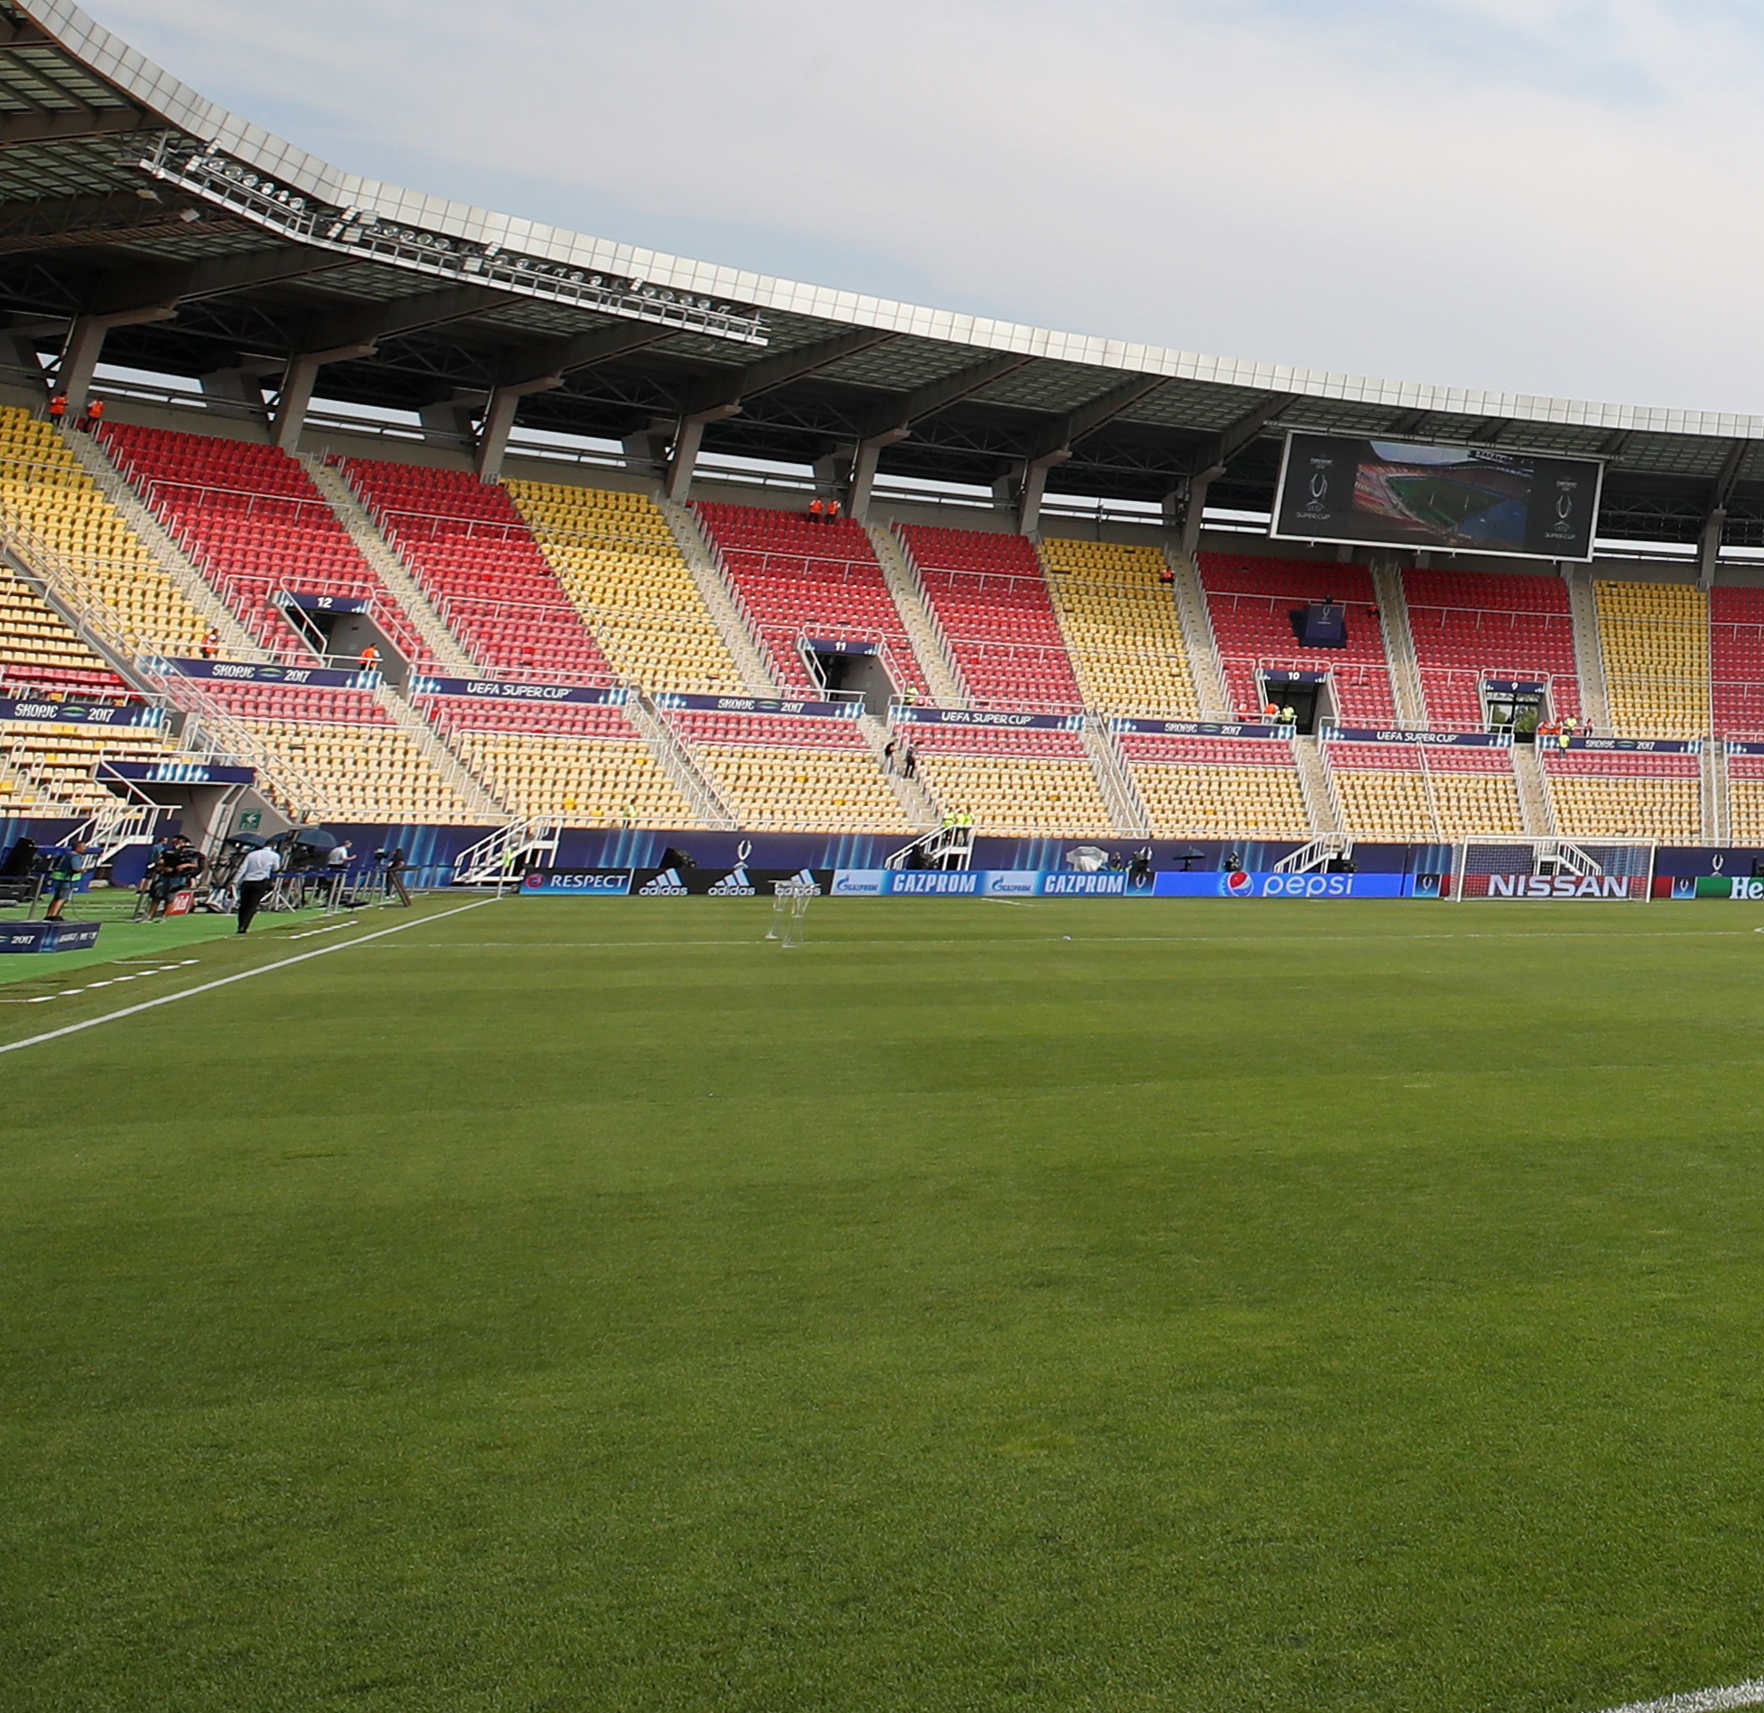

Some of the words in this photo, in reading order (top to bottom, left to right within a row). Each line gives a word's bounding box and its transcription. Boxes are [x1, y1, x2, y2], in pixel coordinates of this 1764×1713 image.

[317, 596, 333, 609] 12
[835, 641, 848, 652] 11
[212, 663, 256, 679] SKOPJE
[283, 668, 312, 684] 2017
[1287, 671, 1301, 681] 10
[466, 681, 500, 694] UEFA
[501, 683, 543, 698] SUPER
[543, 686, 571, 699] CUP
[717, 697, 755, 711] SKOPJE
[780, 701, 806, 714] 2017
[14, 703, 59, 719] SKOPJE
[87, 707, 116, 723] 2017
[941, 710, 970, 722] UEFA
[971, 712, 1007, 725] SUPER
[1008, 714, 1033, 726] CUP
[1164, 721, 1198, 733] SKOPJE
[1220, 724, 1242, 736] 2017
[1376, 731, 1404, 741] UEFA
[1404, 732, 1436, 743] SUPER
[1436, 733, 1458, 744] CUP
[1585, 739, 1615, 749] SKOPJE
[1636, 740, 1656, 750] 2017
[550, 874, 628, 888] RESPECT
[893, 873, 977, 893] GAZPROM
[1045, 874, 1125, 893] GAZPROM
[1262, 873, 1355, 897] pepsi
[1488, 874, 1630, 897] NISSAN
[639, 885, 688, 896] adidas
[708, 885, 756, 896] adidas
[775, 885, 821, 896] adidas
[11, 935, 36, 944] 2017
